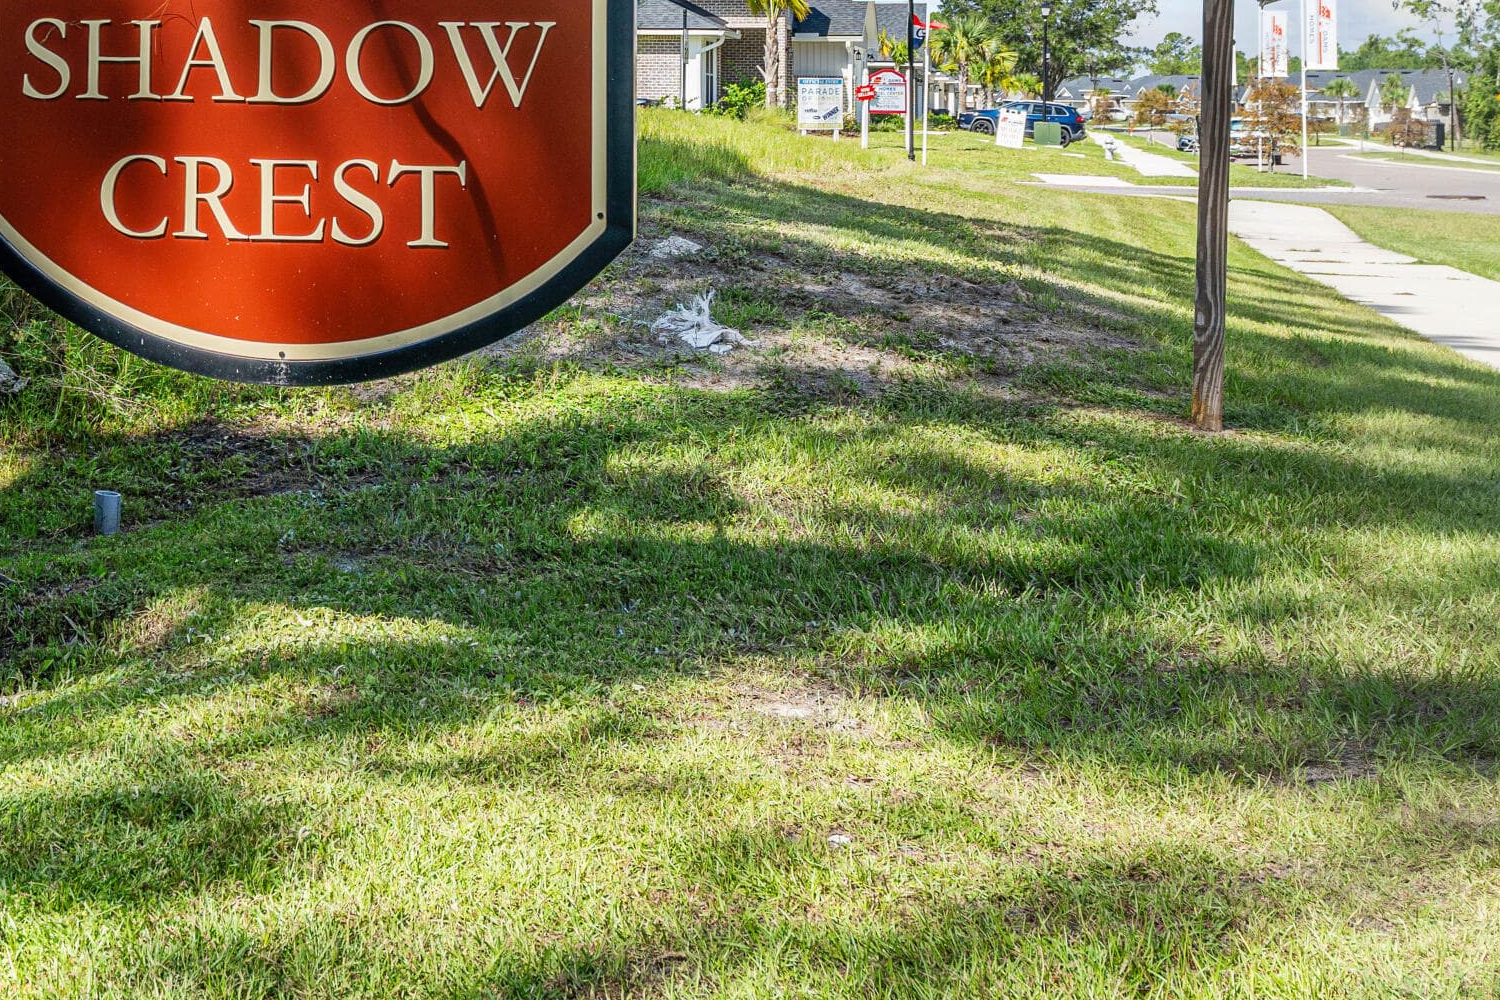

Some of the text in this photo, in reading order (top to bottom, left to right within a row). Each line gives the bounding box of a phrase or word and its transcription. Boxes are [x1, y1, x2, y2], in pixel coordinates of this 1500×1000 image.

[21, 16, 557, 108] SHADOW
[801, 87, 841, 96] PARADE
[100, 154, 467, 248] CREST
